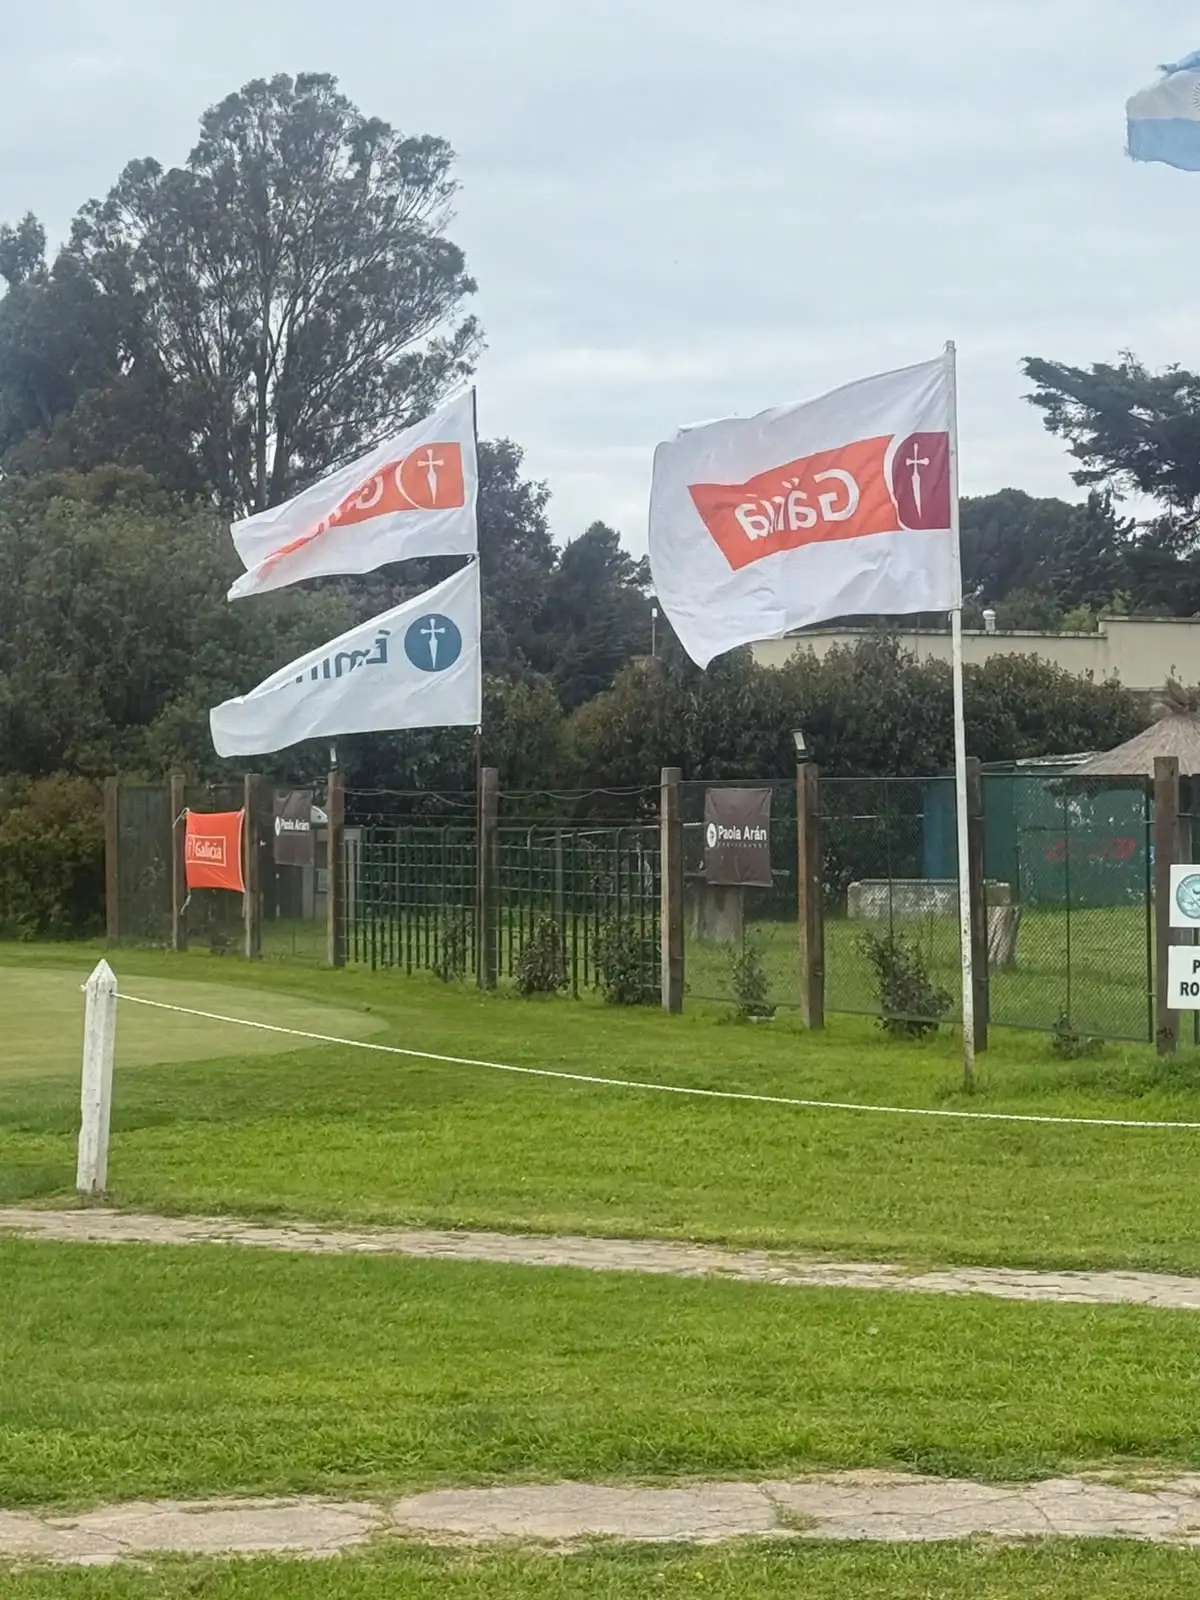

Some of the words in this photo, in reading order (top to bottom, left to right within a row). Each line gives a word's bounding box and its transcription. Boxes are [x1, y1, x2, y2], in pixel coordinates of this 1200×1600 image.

[718, 825, 742, 841] Paola
[743, 825, 767, 841] Arán
[195, 840, 222, 860] Galicia
